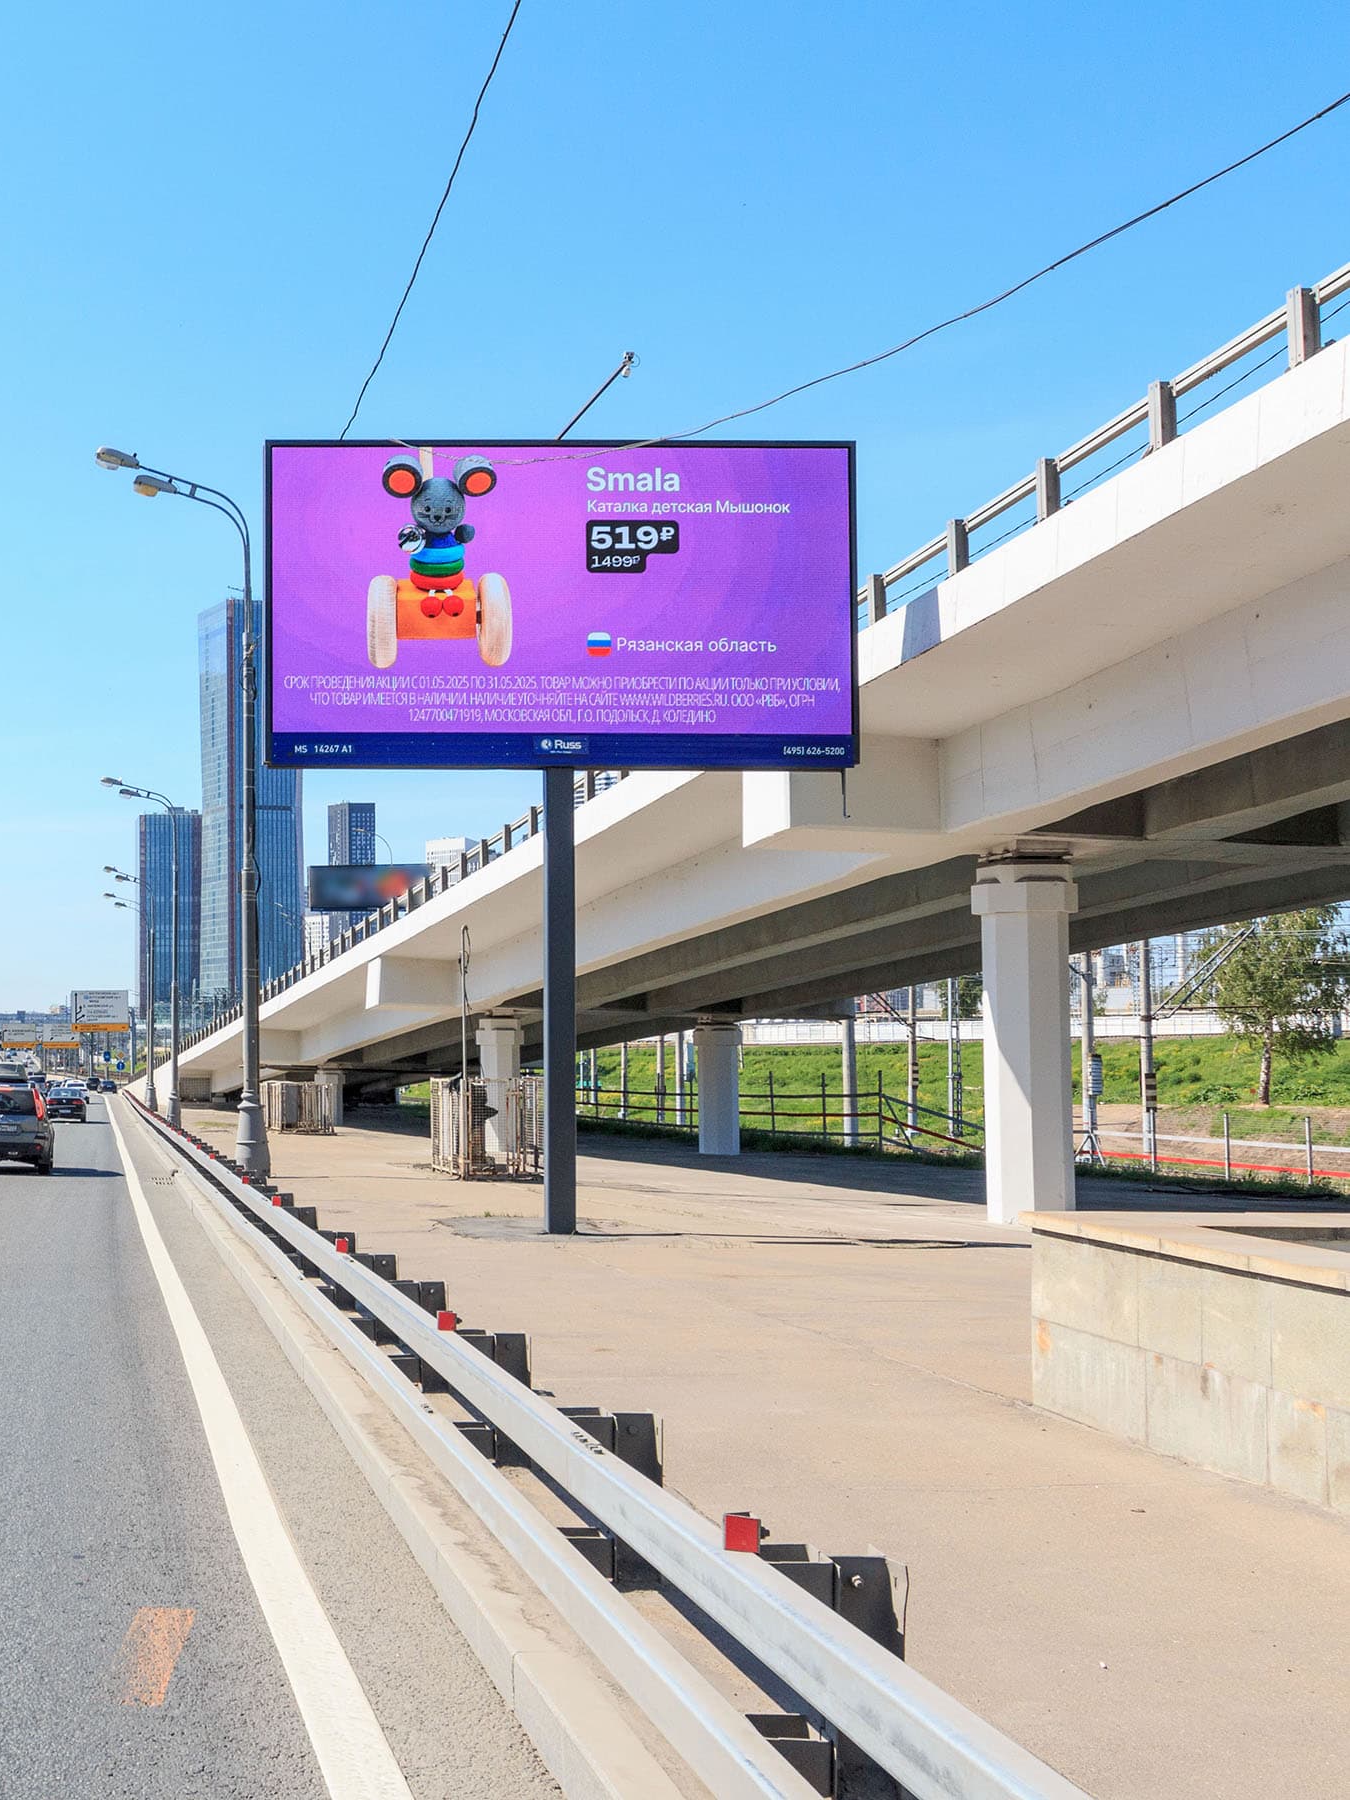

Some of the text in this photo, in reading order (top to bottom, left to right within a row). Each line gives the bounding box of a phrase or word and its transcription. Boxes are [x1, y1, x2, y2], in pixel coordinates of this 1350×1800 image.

[586, 466, 680, 492] Smala
[587, 500, 790, 515] Каталка детская Мышонок
[616, 637, 777, 653] Рязанская область
[284, 675, 841, 693] СРОК ПРОВЕДЕНИЯ АКЦИИ С 01.05.2025 ПО 31.05.2025. ТОВАР МОЖНО ПРИОБРЕСТИ ПО АКЦИИ ТОЛЬКО ПРИ УСЛОВИИ,
[310, 692, 330, 706] ЧТО
[332, 692, 363, 706] ТОВАР
[363, 692, 408, 706] ИМЕЕТСЯ
[409, 692, 416, 706] В
[470, 692, 517, 706] НАЛИЧИЕ
[517, 690, 573, 706] УТОЧНЯЙТЕ
[574, 693, 589, 706] НА
[589, 690, 618, 706] САЙТЕ
[789, 693, 815, 707] ОГРН
[484, 708, 550, 722] МОСКОВСКАЯ
[663, 709, 717, 725] КОЛЕДИНО
[294, 745, 308, 753] MS
[314, 745, 339, 753] 14267
[554, 739, 582, 750] Russ
[806, 746, 845, 756] 626-5200
